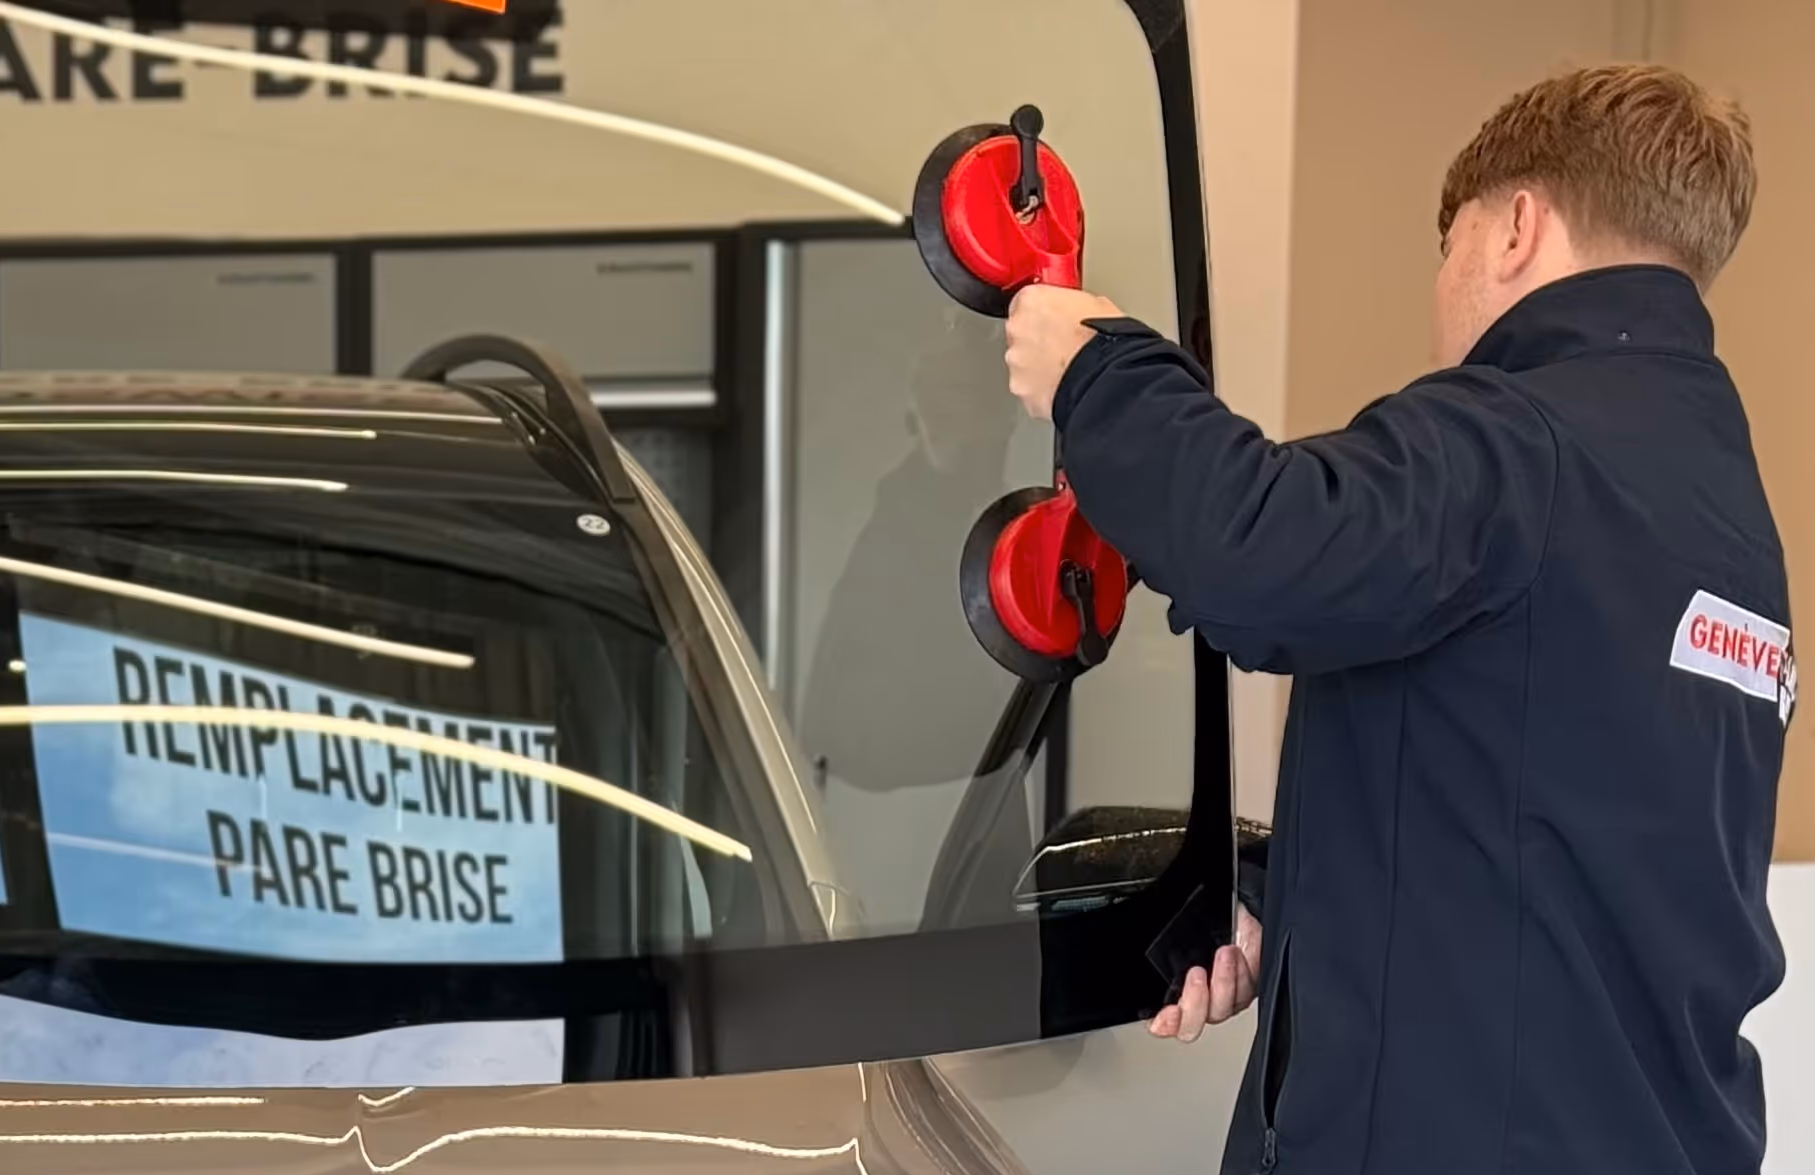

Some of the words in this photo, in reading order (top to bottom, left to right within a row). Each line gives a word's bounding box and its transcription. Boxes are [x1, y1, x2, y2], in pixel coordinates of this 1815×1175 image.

[1689, 614, 1779, 678] GENÈVE
[113, 646, 557, 824] REMPLACEMENT
[207, 810, 359, 915] PARE
[366, 840, 513, 924] BRISE
